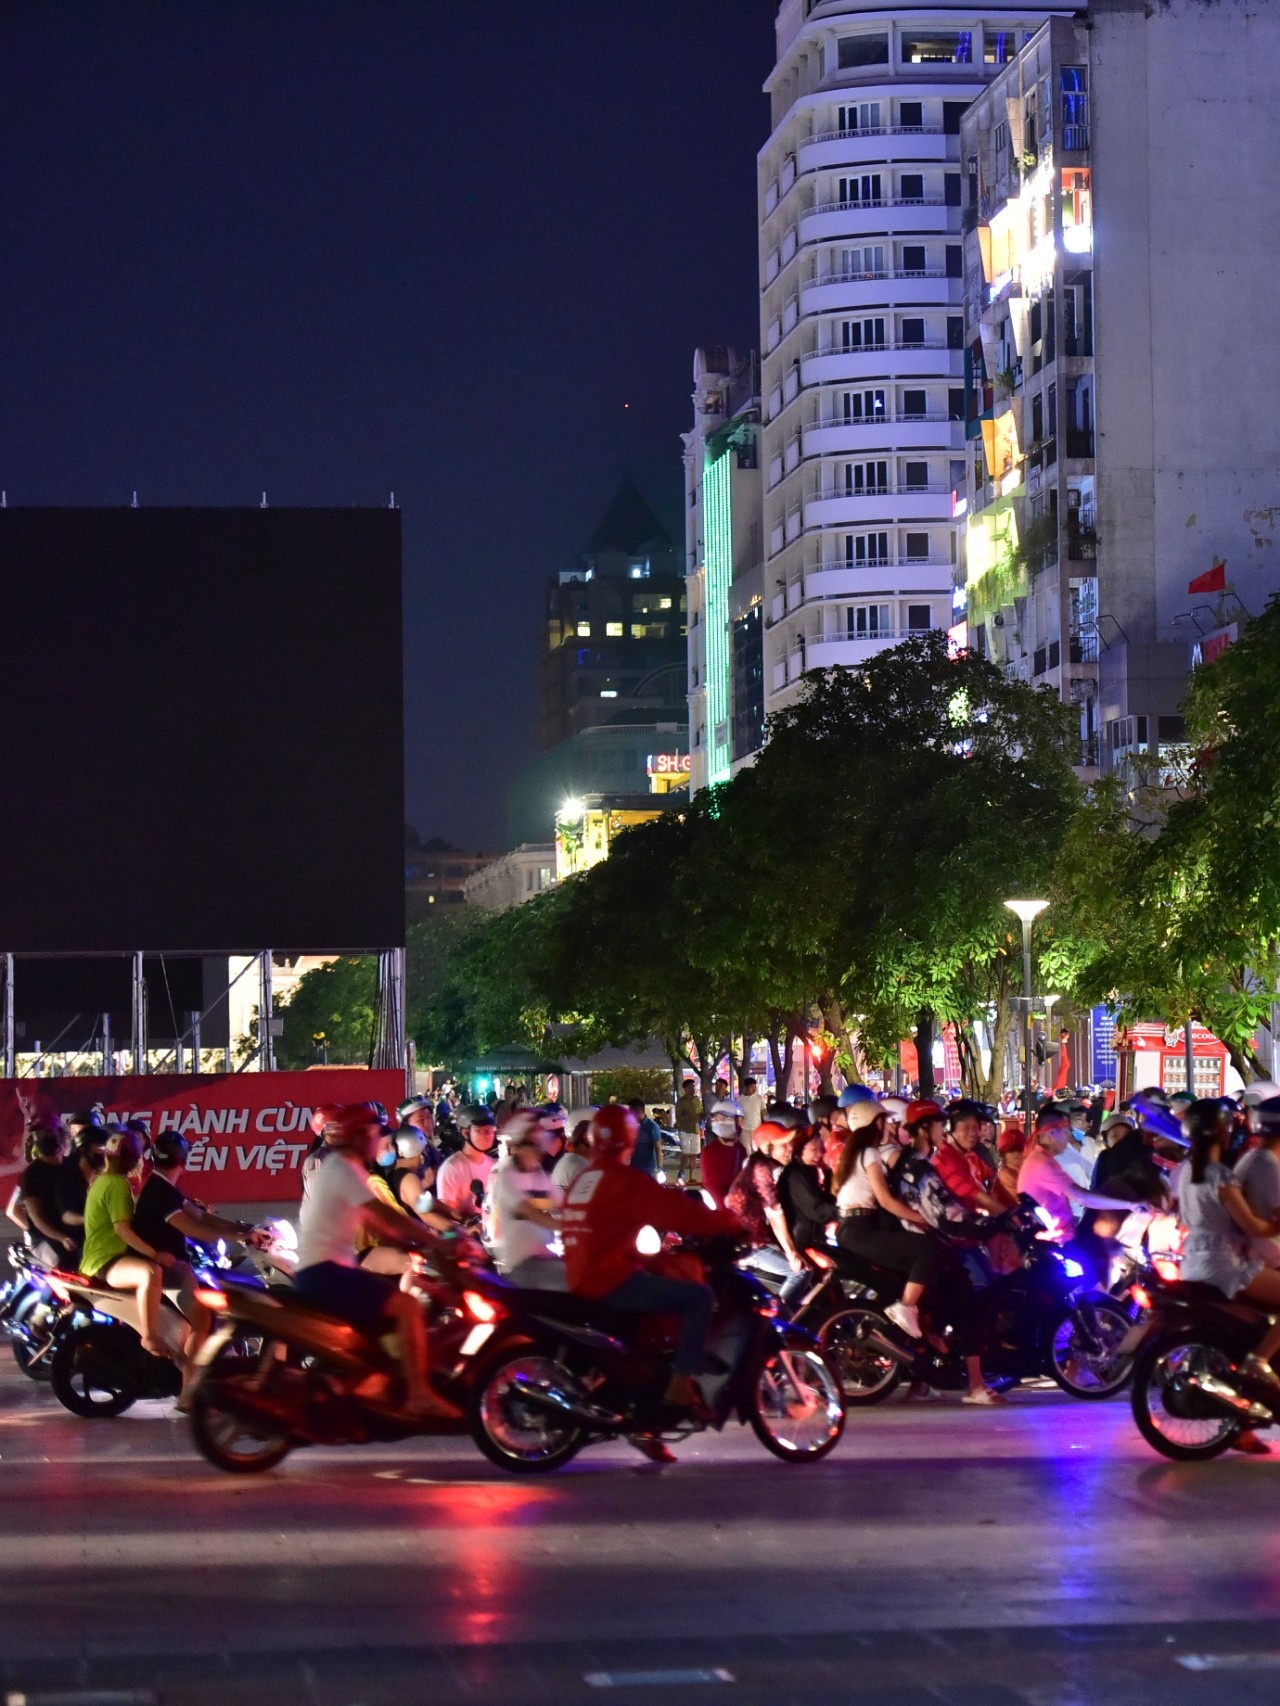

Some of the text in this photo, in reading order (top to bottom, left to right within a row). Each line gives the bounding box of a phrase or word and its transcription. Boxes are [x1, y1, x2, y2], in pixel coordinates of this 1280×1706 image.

[158, 1103, 250, 1135] HÀNH
[255, 1101, 316, 1132] CÙN
[235, 1138, 308, 1176] VIỆT
